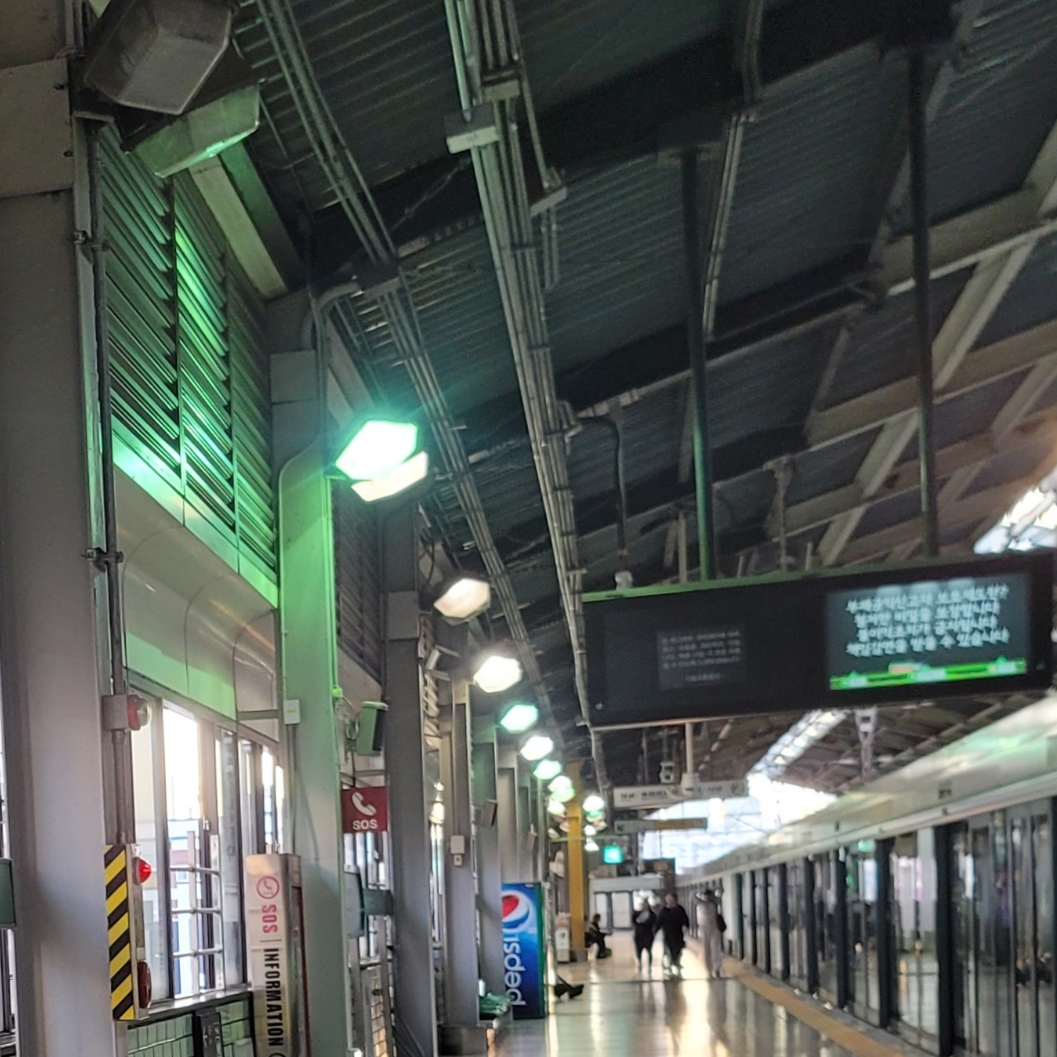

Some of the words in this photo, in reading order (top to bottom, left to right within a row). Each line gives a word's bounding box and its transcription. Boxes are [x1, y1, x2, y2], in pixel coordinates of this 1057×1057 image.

[352, 819, 378, 830] SOS
[261, 904, 278, 934] SOS
[264, 948, 284, 1046] INFORMATION
